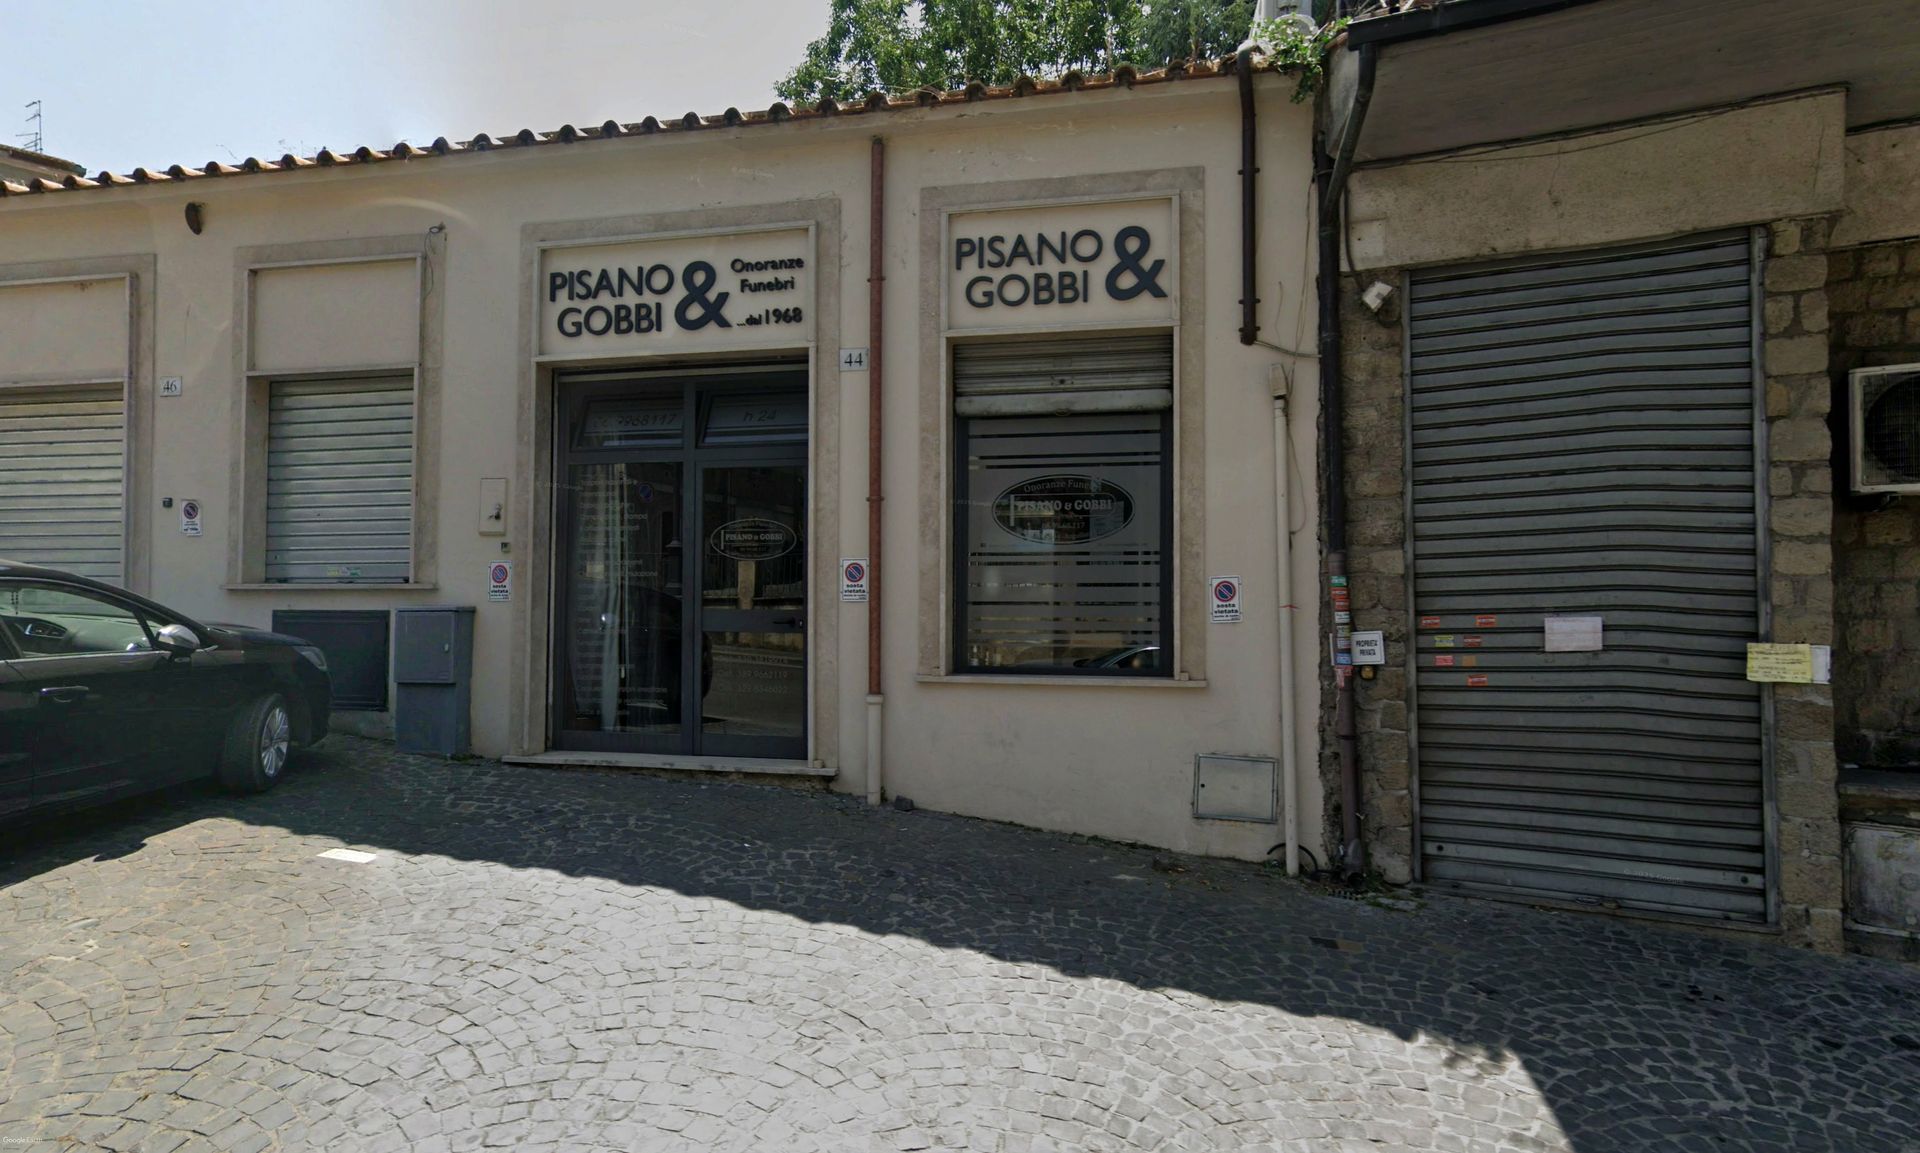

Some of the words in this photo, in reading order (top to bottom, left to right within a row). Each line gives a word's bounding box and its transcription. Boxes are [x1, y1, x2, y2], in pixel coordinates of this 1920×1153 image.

[955, 228, 1104, 271] PISANO
[1104, 225, 1169, 302] &
[730, 257, 805, 274] Onoranze
[549, 263, 675, 303] PISANO
[674, 260, 732, 331] &
[740, 275, 795, 294] Funebri
[965, 269, 1089, 309] GOBBI
[557, 301, 662, 338] GOBBI
[764, 306, 803, 326] 1968
[843, 352, 864, 367] 44
[163, 380, 178, 393] 46
[1074, 498, 1113, 512] GOBBI
